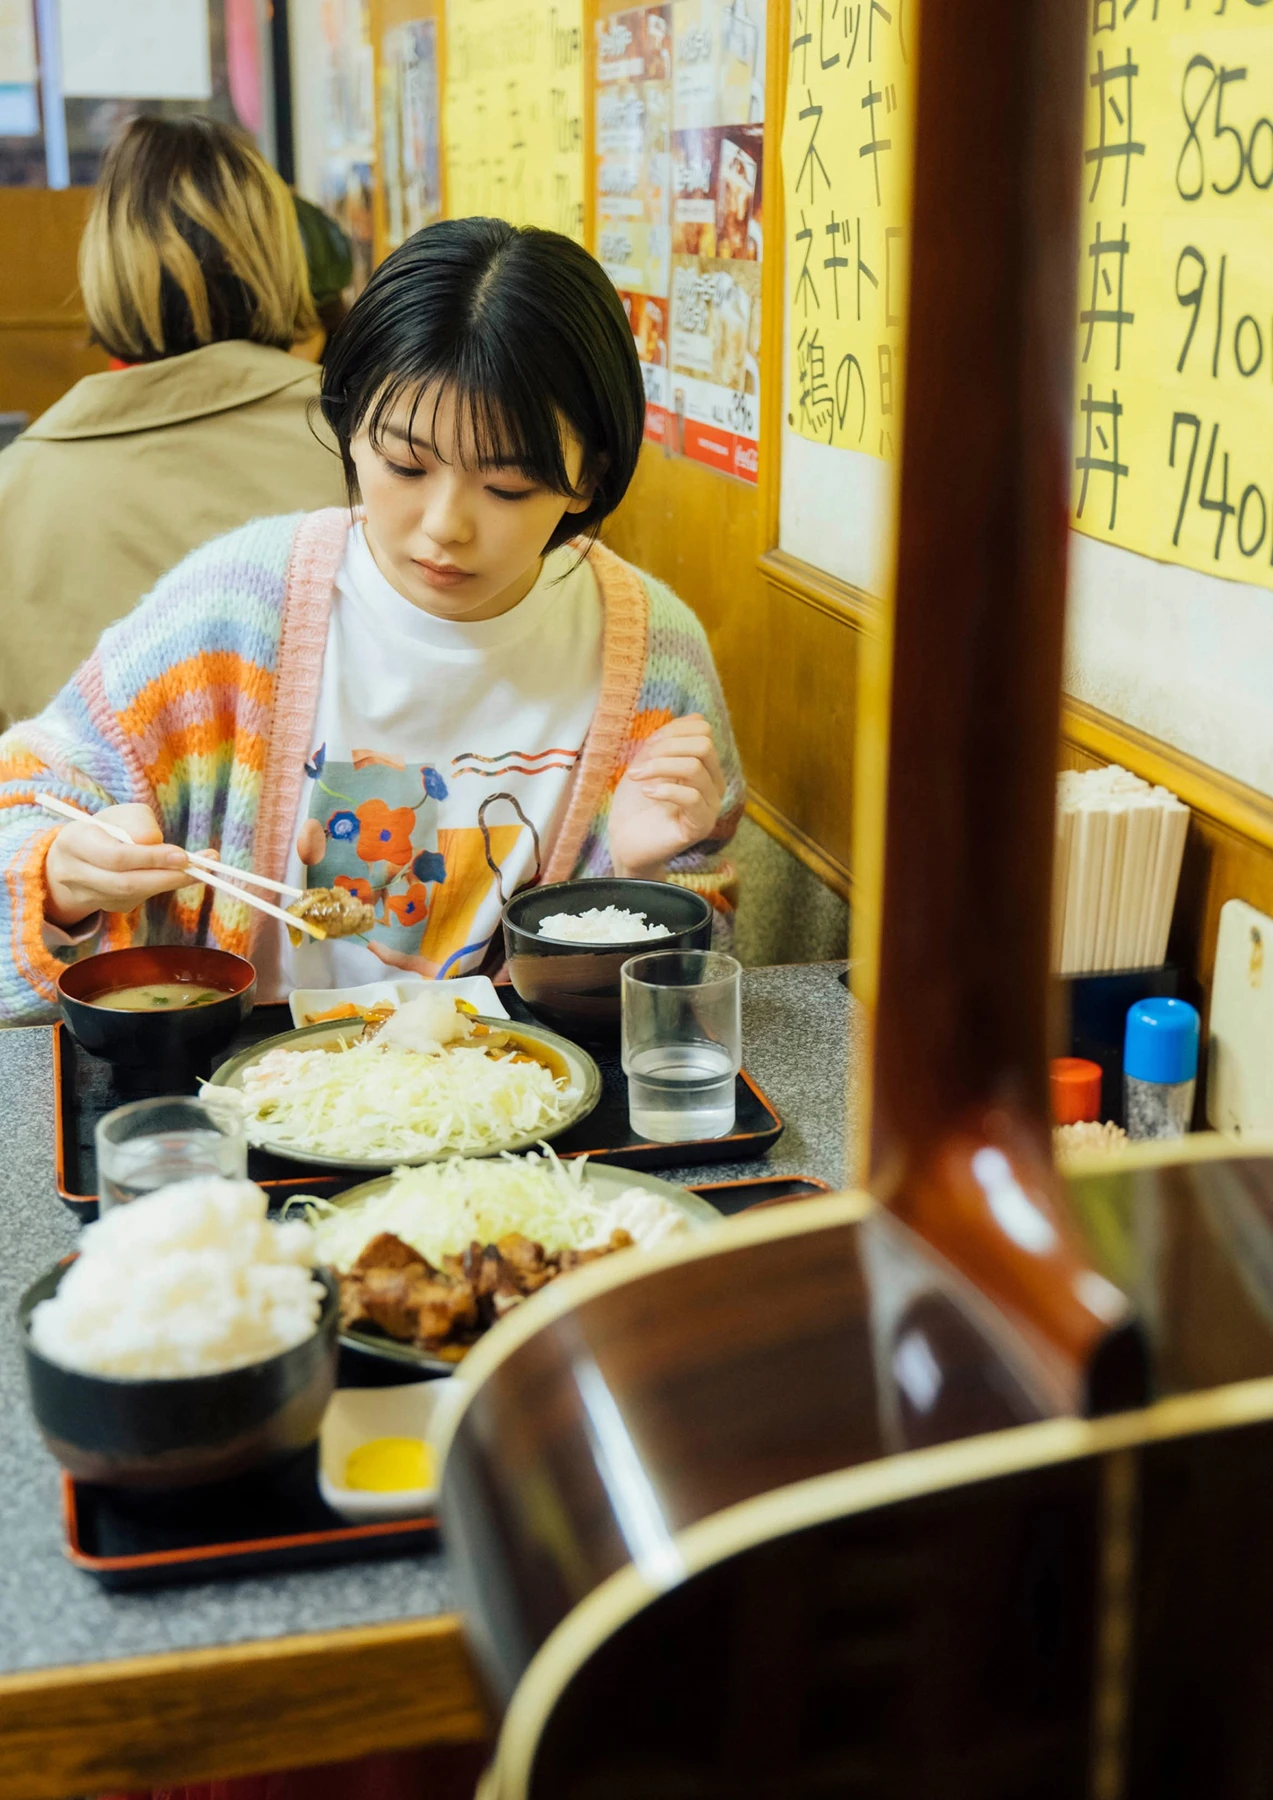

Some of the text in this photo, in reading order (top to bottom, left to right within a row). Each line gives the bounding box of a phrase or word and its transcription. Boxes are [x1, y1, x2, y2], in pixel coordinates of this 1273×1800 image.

[1083, 47, 1145, 206] 丼
[1176, 53, 1273, 201] 850
[1080, 222, 1135, 371] 丼
[1175, 245, 1273, 384] 910
[1075, 383, 1128, 531] 丼
[1168, 411, 1273, 568] 740
